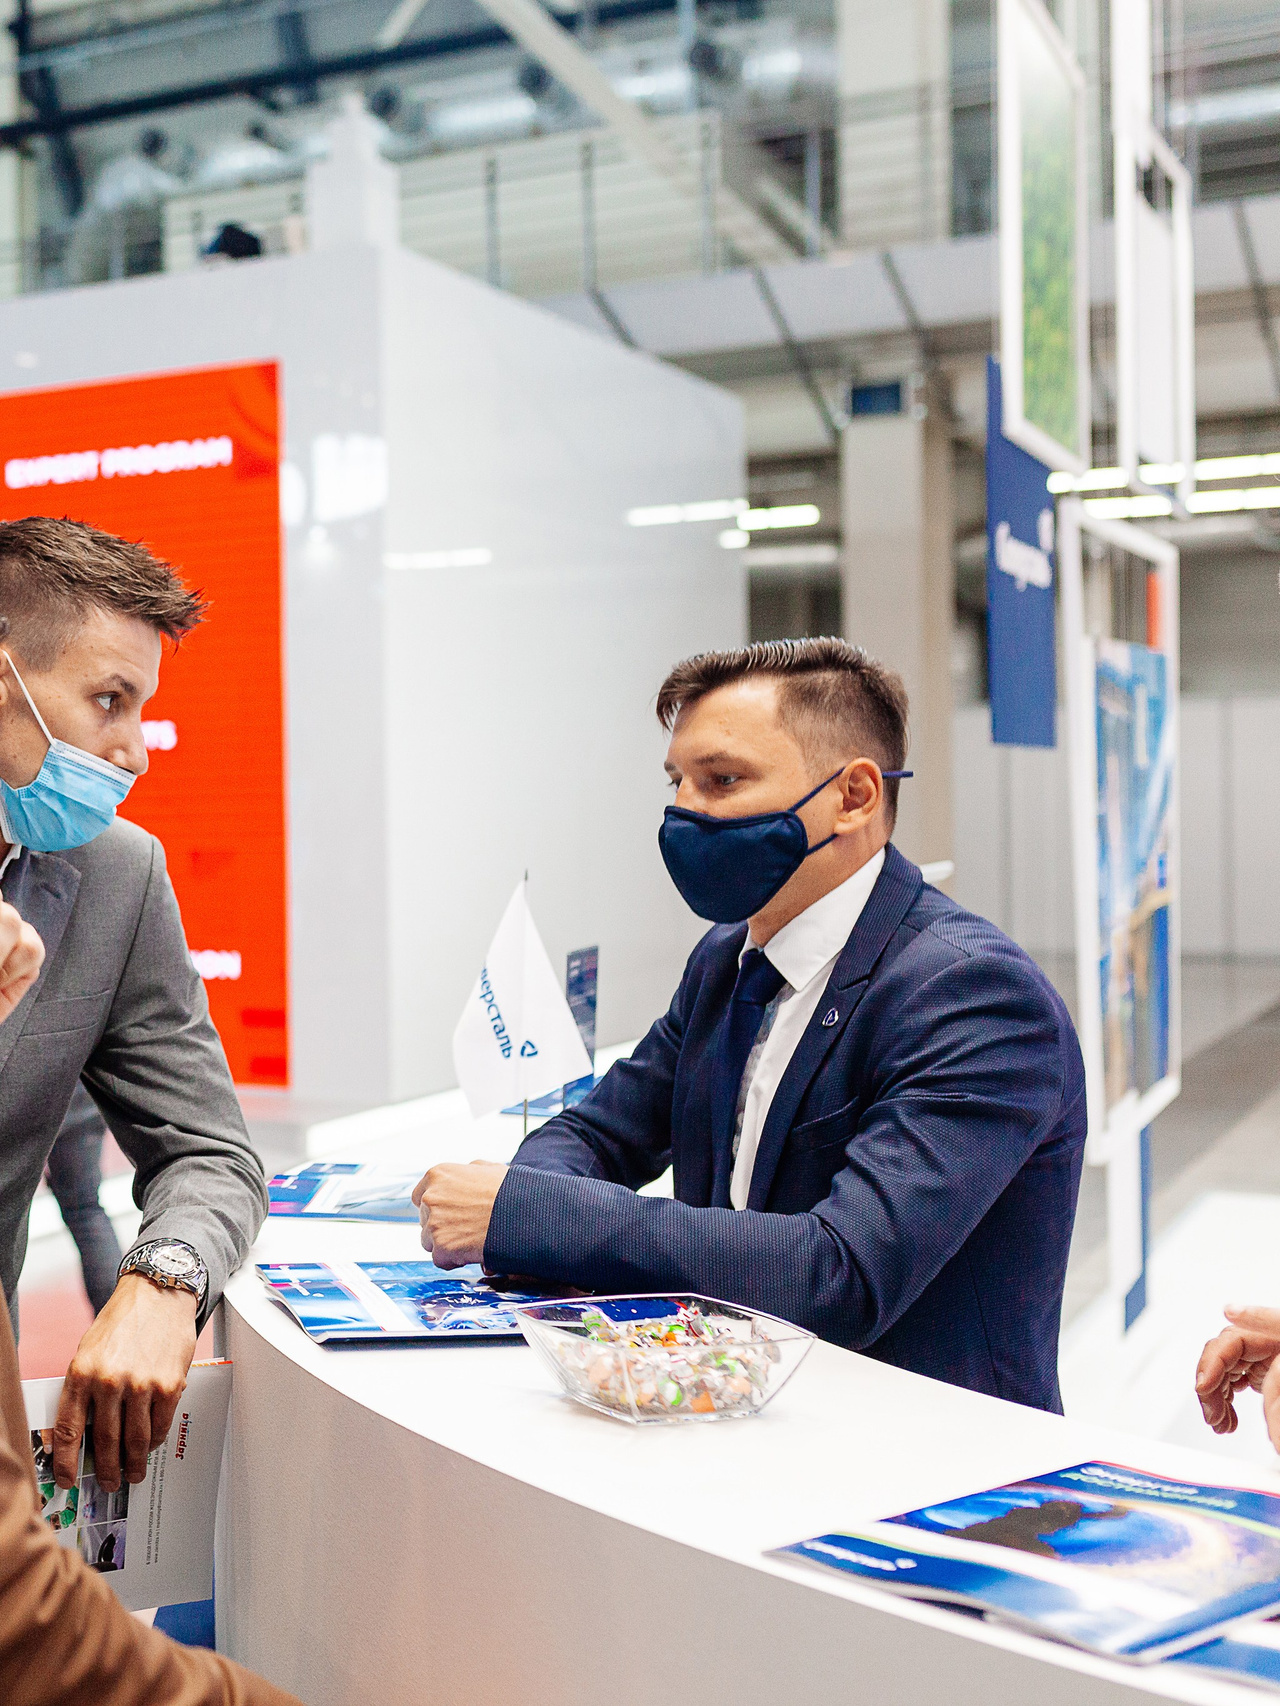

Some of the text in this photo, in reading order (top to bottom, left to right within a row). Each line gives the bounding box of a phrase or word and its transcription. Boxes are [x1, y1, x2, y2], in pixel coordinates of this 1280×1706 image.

[5, 435, 233, 489] EXPERT PROGRAM
[175, 1413, 192, 1460] Зарница
